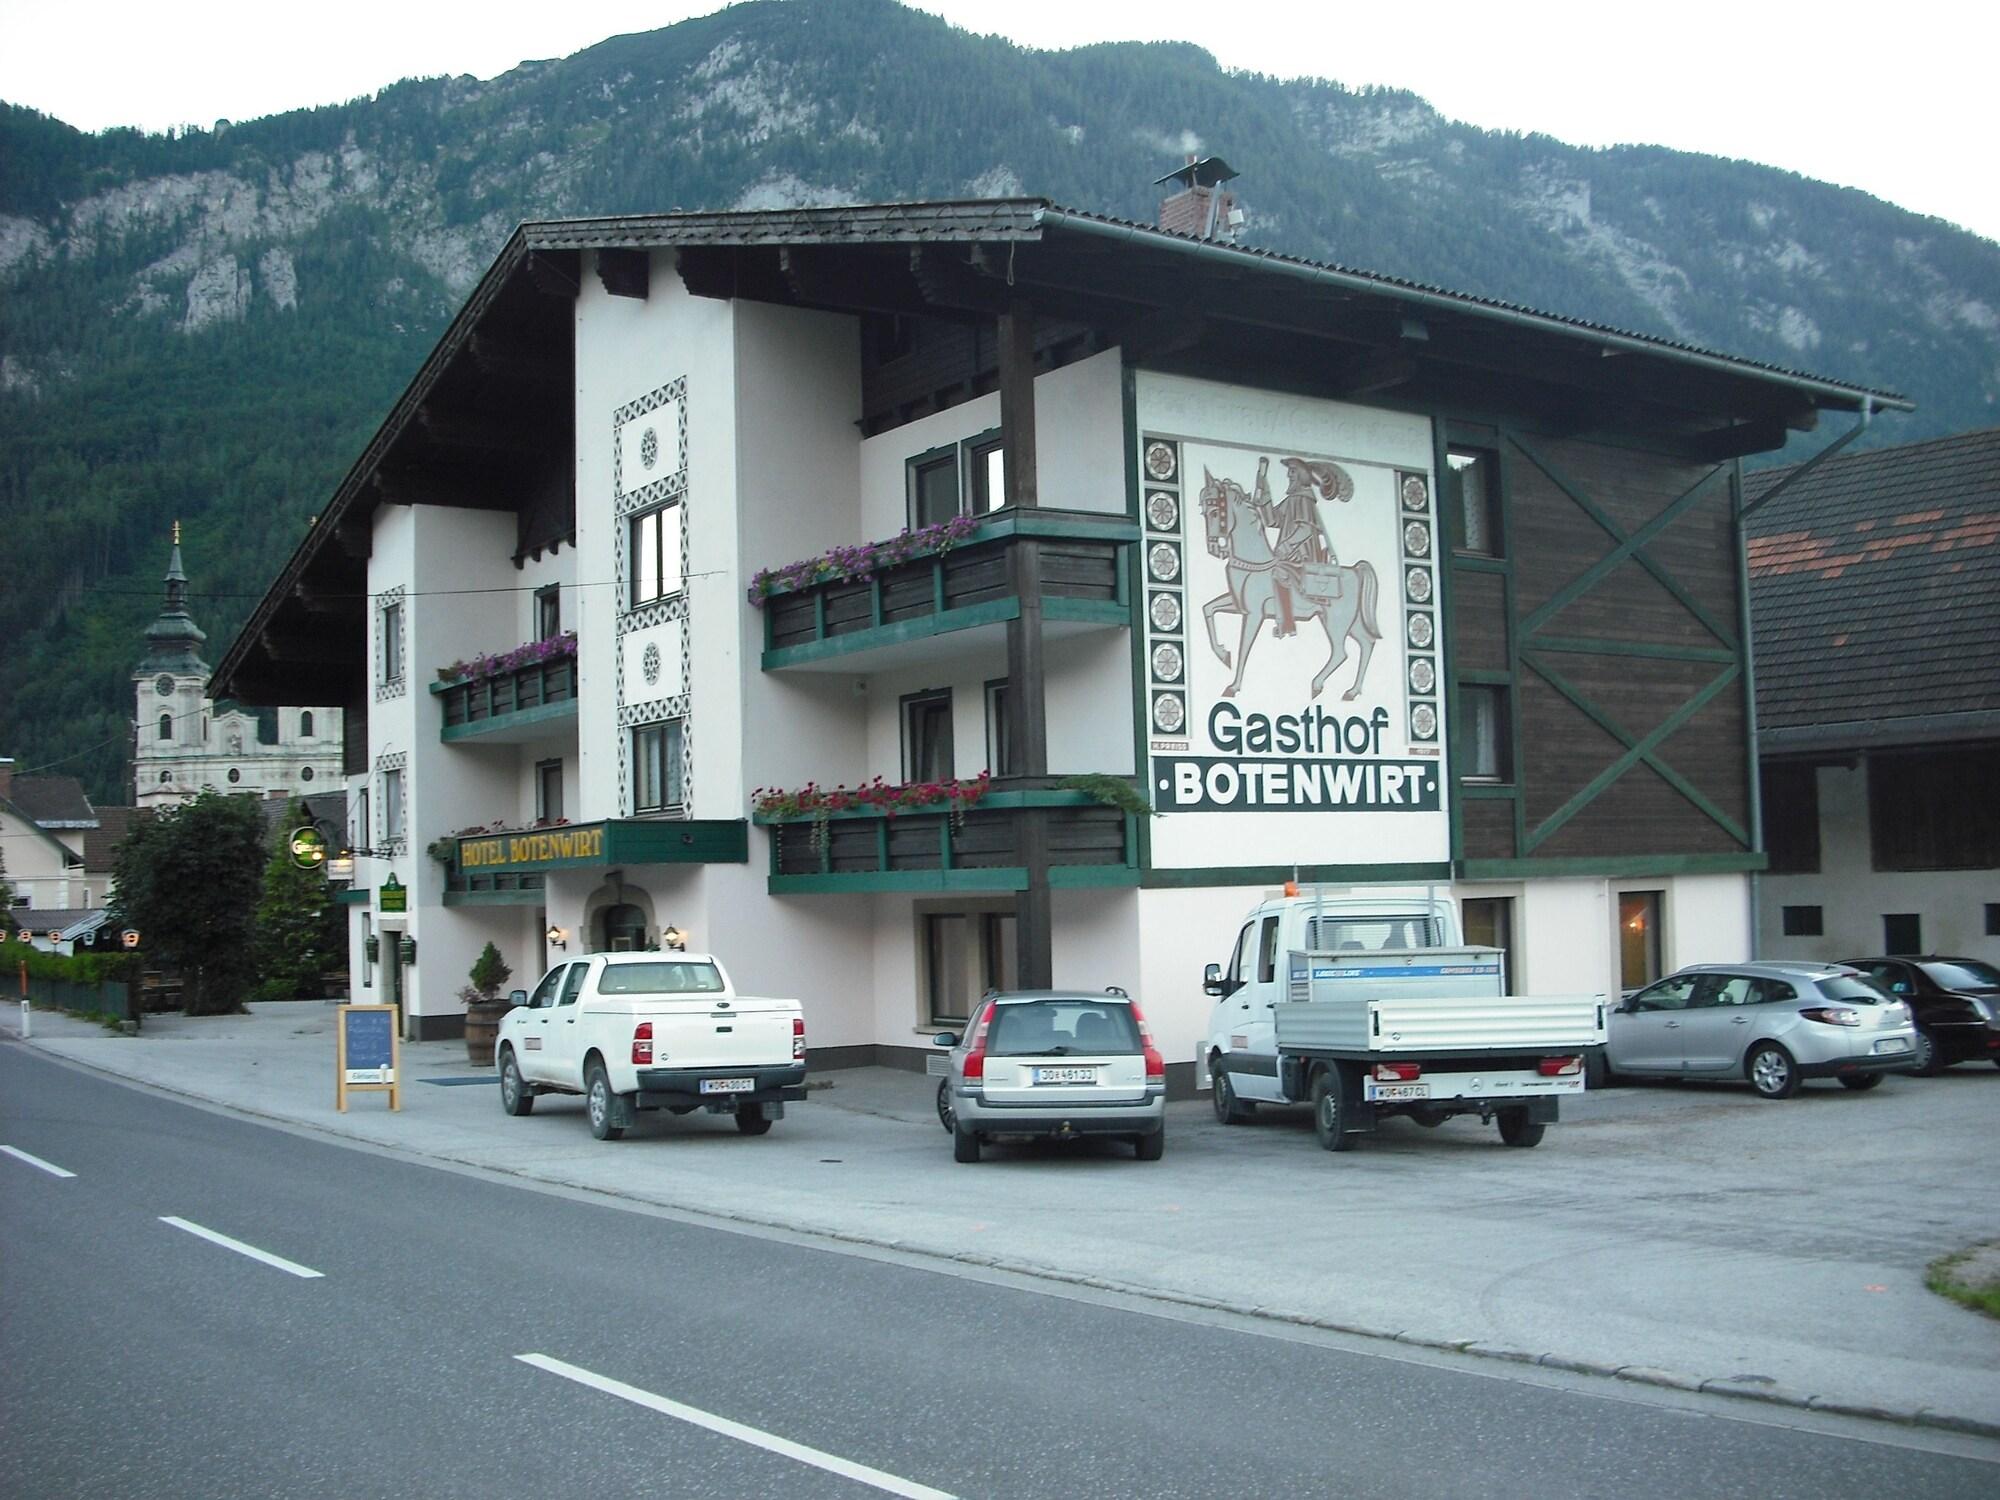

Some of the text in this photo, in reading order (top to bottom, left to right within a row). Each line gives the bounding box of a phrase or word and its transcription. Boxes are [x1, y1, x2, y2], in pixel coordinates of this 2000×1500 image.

[1208, 701, 1389, 755] Gasthof
[1174, 762, 1426, 805] BOTENWIRT
[461, 828, 603, 867] HOTEL BOTENWIRT
